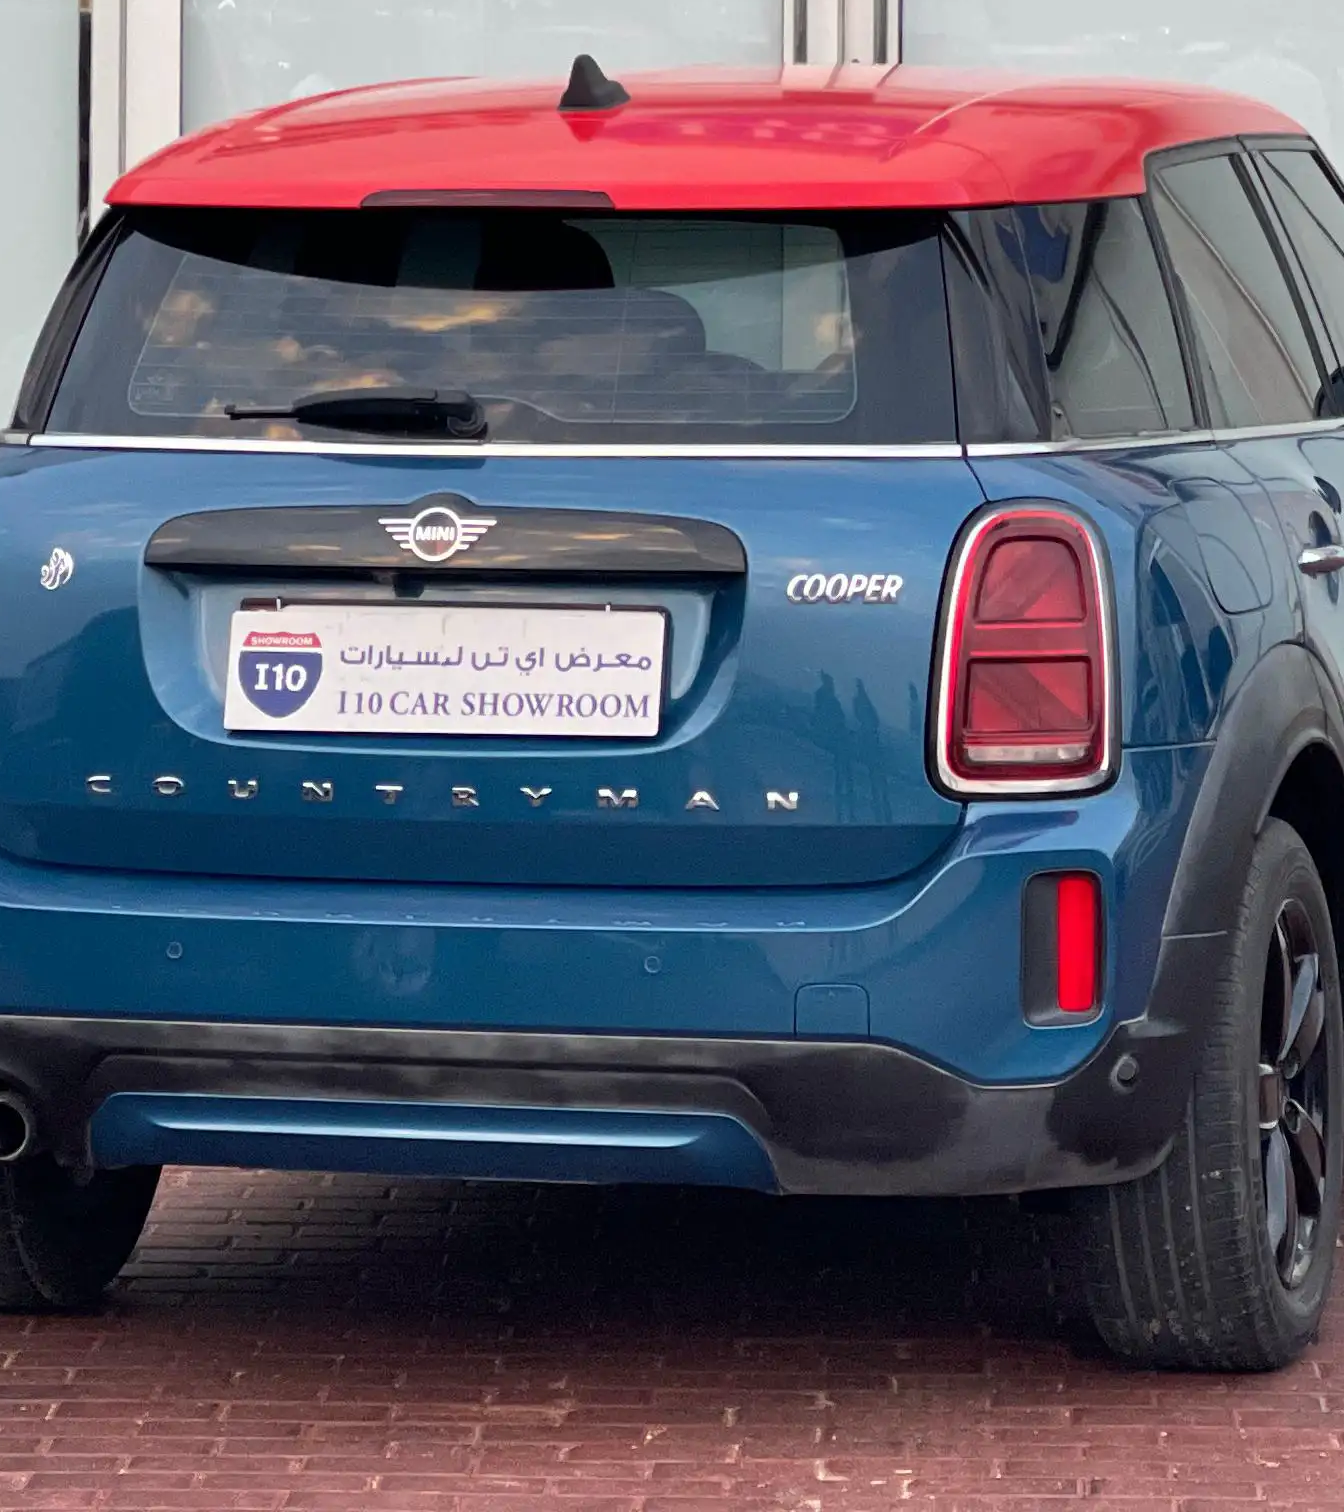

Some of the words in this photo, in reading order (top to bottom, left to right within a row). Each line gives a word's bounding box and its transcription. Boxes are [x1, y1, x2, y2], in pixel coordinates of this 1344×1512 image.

[415, 525, 455, 542] MINI
[786, 573, 904, 604] COOPER
[250, 635, 313, 647] SHOWROOM
[555, 647, 652, 673] معرض
[253, 662, 308, 692] I10
[389, 690, 452, 717] CAR
[460, 691, 651, 719] SHOWROOM
[86, 774, 800, 812] COUNTRYMAN
